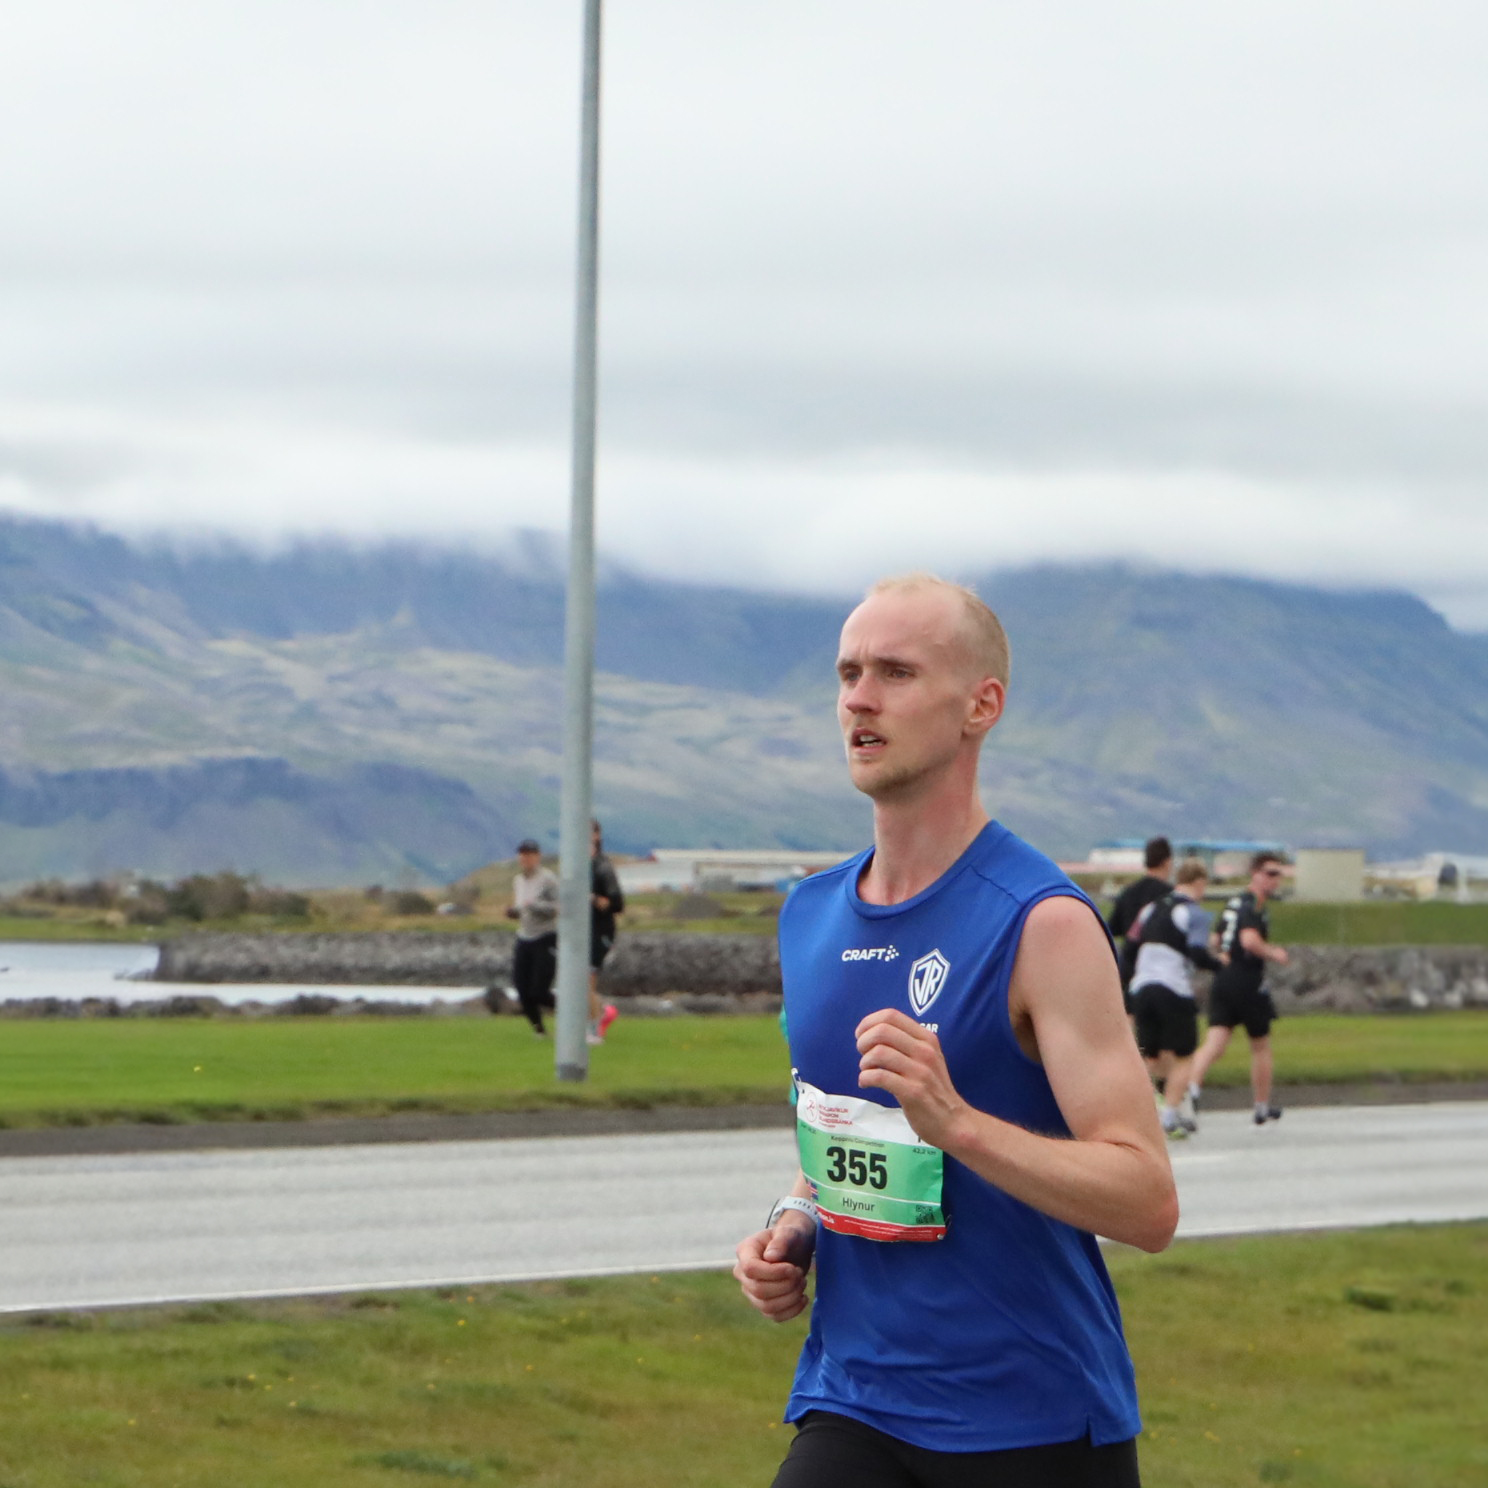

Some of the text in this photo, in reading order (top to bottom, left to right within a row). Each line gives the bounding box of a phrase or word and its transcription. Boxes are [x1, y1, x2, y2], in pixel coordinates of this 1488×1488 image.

[841, 949, 886, 962] CRAFT
[826, 1146, 888, 1190] 355
[842, 1198, 875, 1211] Hlynur
